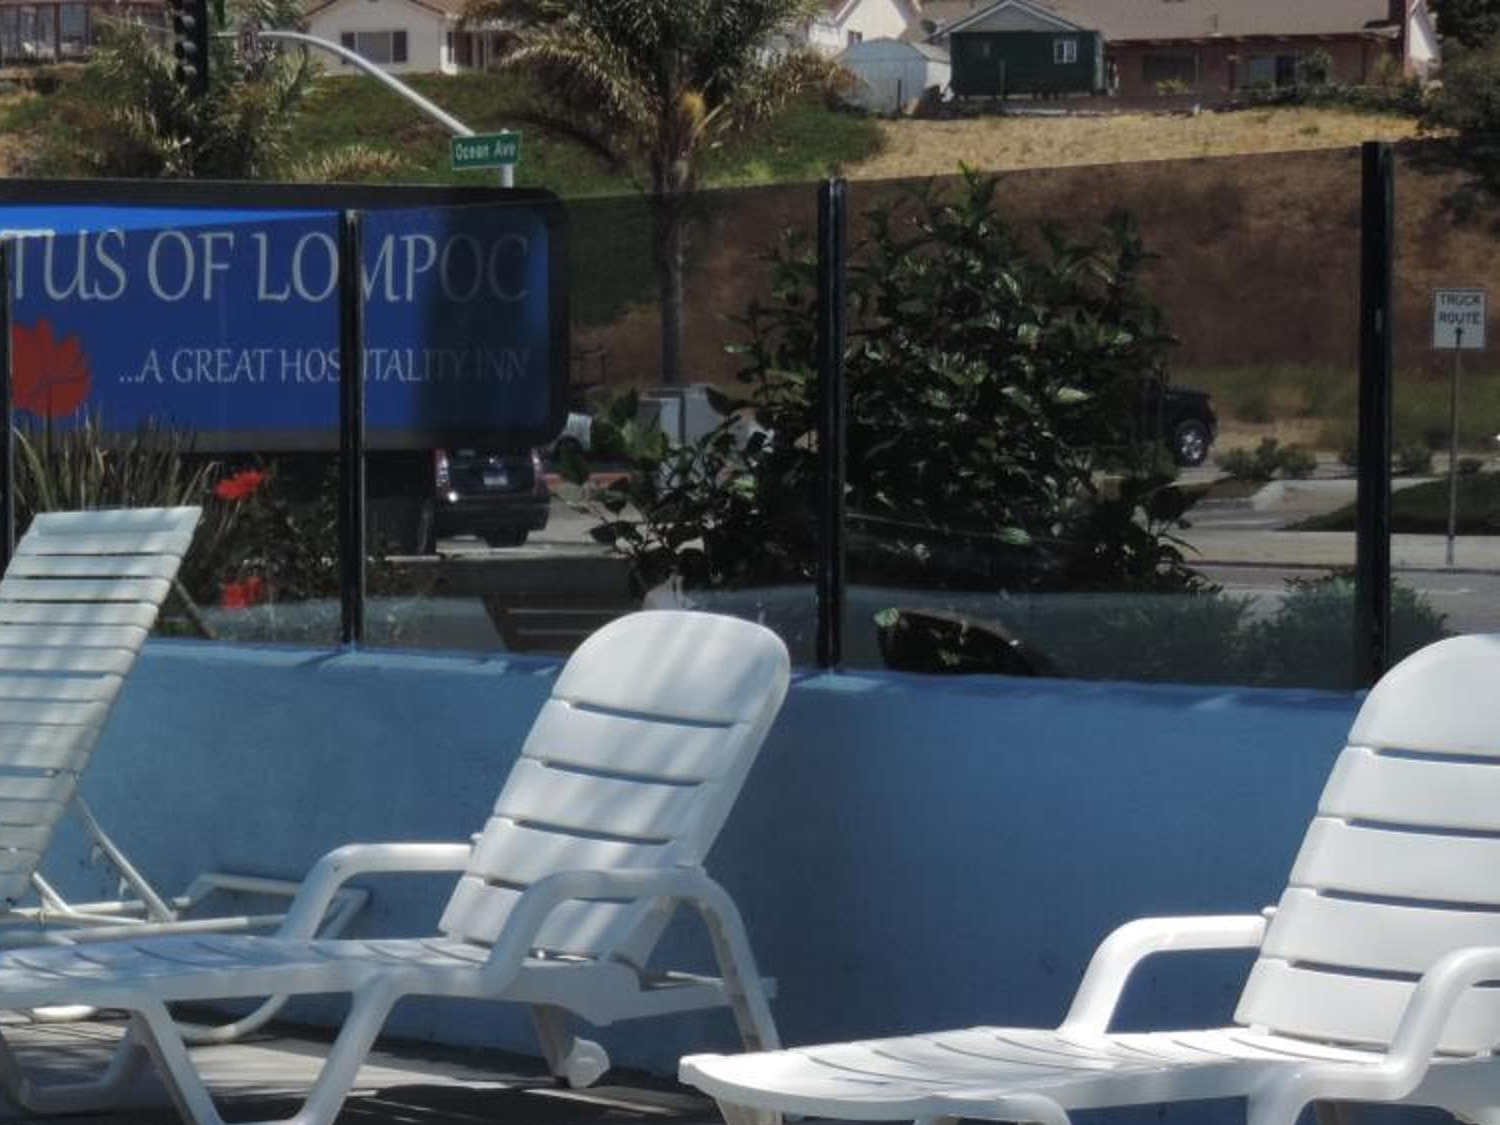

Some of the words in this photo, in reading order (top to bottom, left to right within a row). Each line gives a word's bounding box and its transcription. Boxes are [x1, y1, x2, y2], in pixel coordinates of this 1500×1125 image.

[147, 229, 235, 302] OF
[252, 231, 531, 303] LOMPOC
[1439, 311, 1481, 325] ROUTE
[171, 348, 274, 384] GREAT
[281, 348, 469, 384] HOSITALITY
[476, 348, 531, 384] INN
